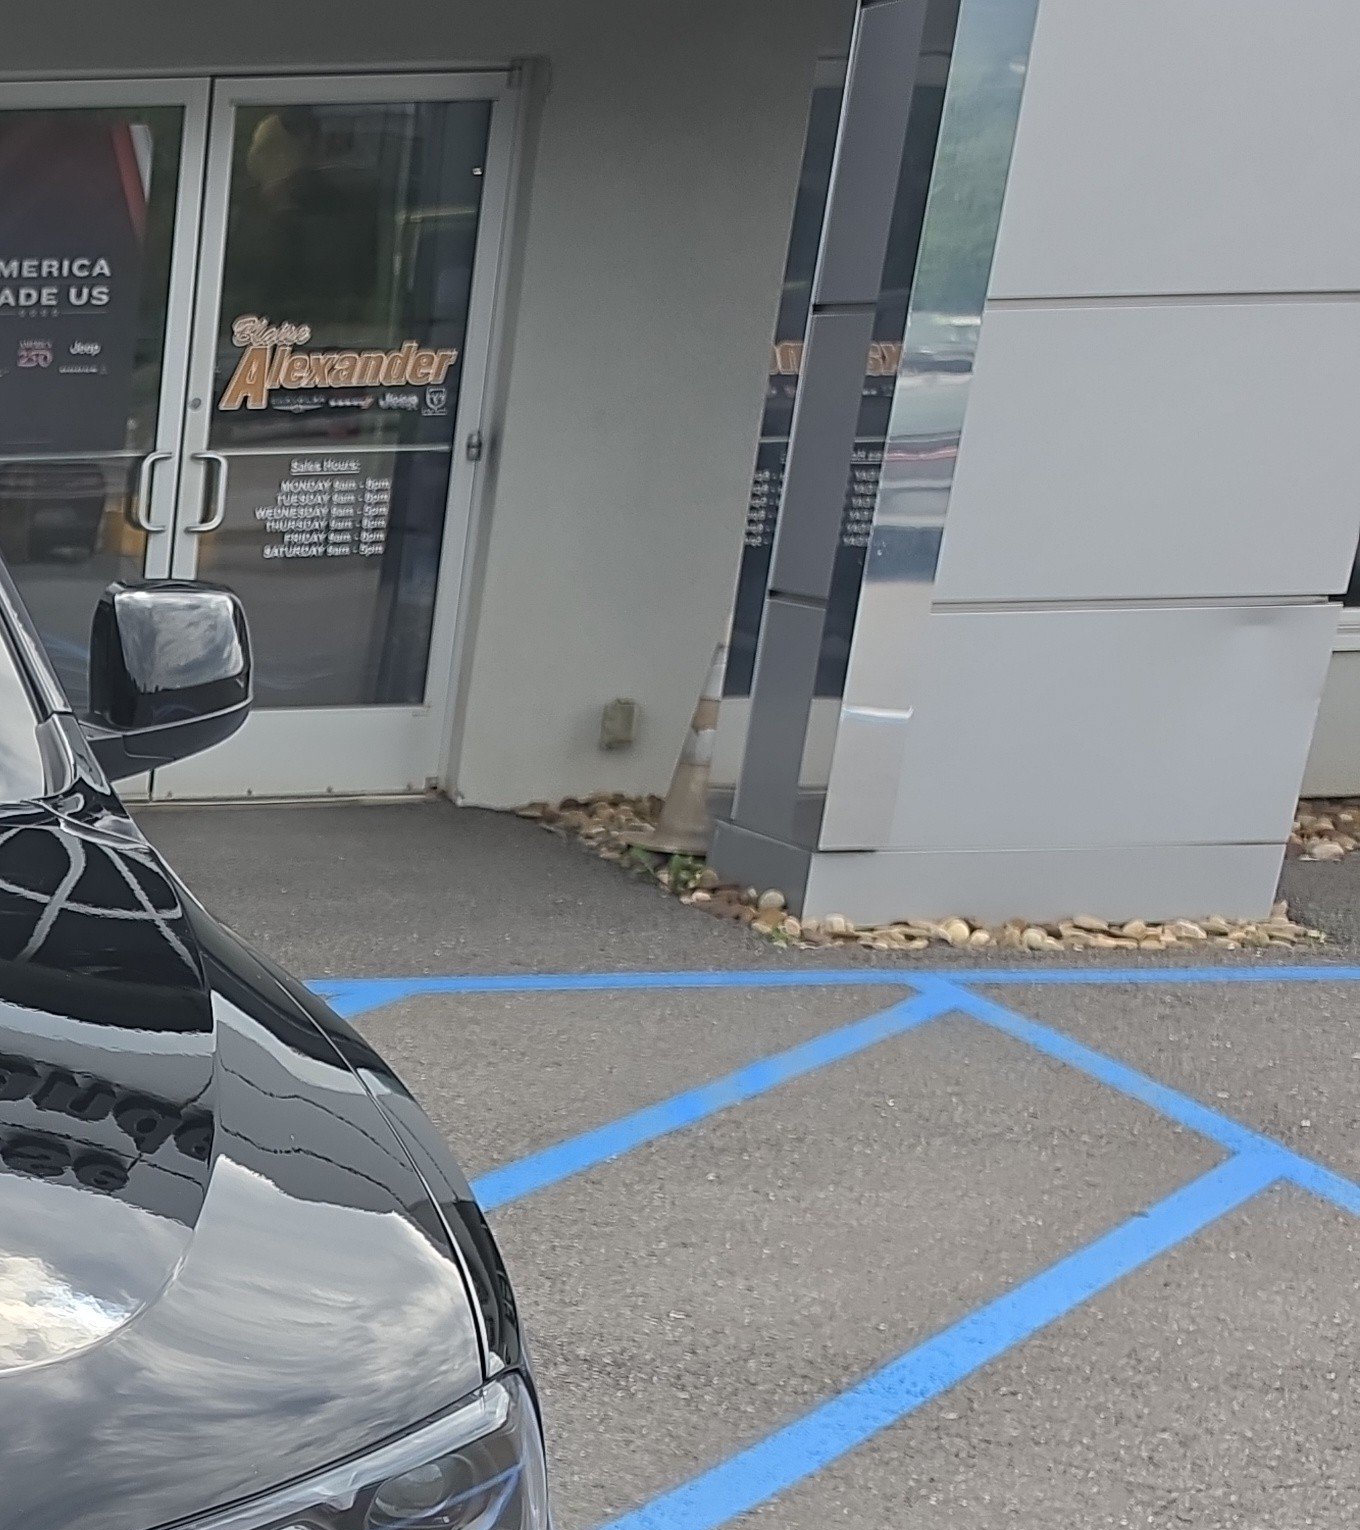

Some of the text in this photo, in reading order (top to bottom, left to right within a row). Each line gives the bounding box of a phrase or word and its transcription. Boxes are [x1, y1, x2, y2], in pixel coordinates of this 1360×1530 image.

[69, 285, 111, 305] US
[218, 339, 458, 411] Alexander
[290, 459, 322, 473] Sales
[280, 478, 332, 492] MONDAY
[277, 492, 331, 506] TUESDAY
[255, 506, 329, 520] WEDNESDAY
[265, 518, 328, 532] THURSDAY
[283, 531, 327, 545] FRIDAY
[263, 544, 325, 558] SATURDAY
